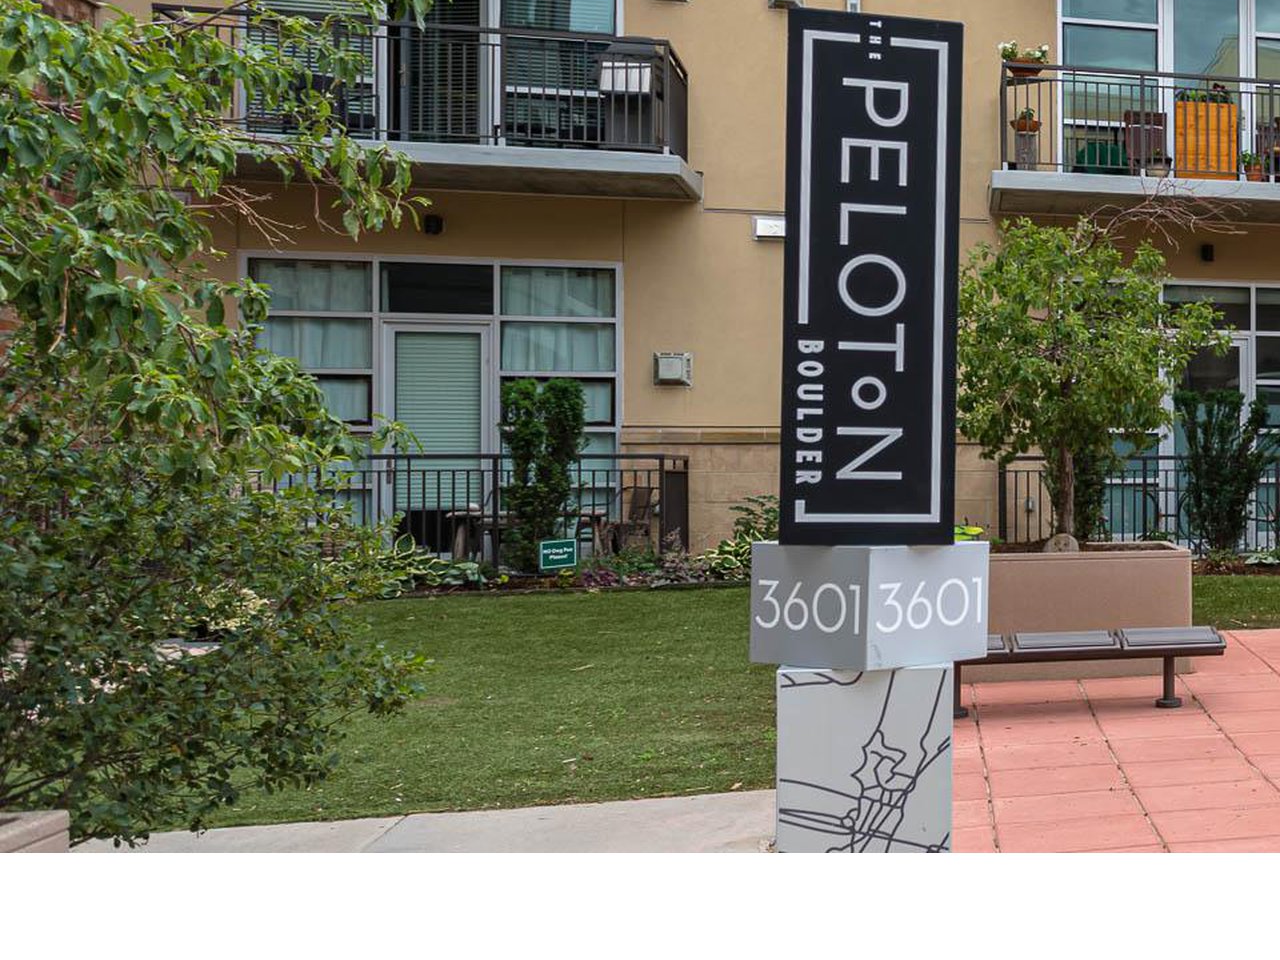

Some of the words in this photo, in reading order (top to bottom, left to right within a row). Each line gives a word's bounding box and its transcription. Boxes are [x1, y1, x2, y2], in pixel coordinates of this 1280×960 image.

[868, 20, 883, 61] THE
[794, 339, 826, 486] BOULDER
[755, 579, 861, 635] 3601
[876, 577, 983, 633] 3601
